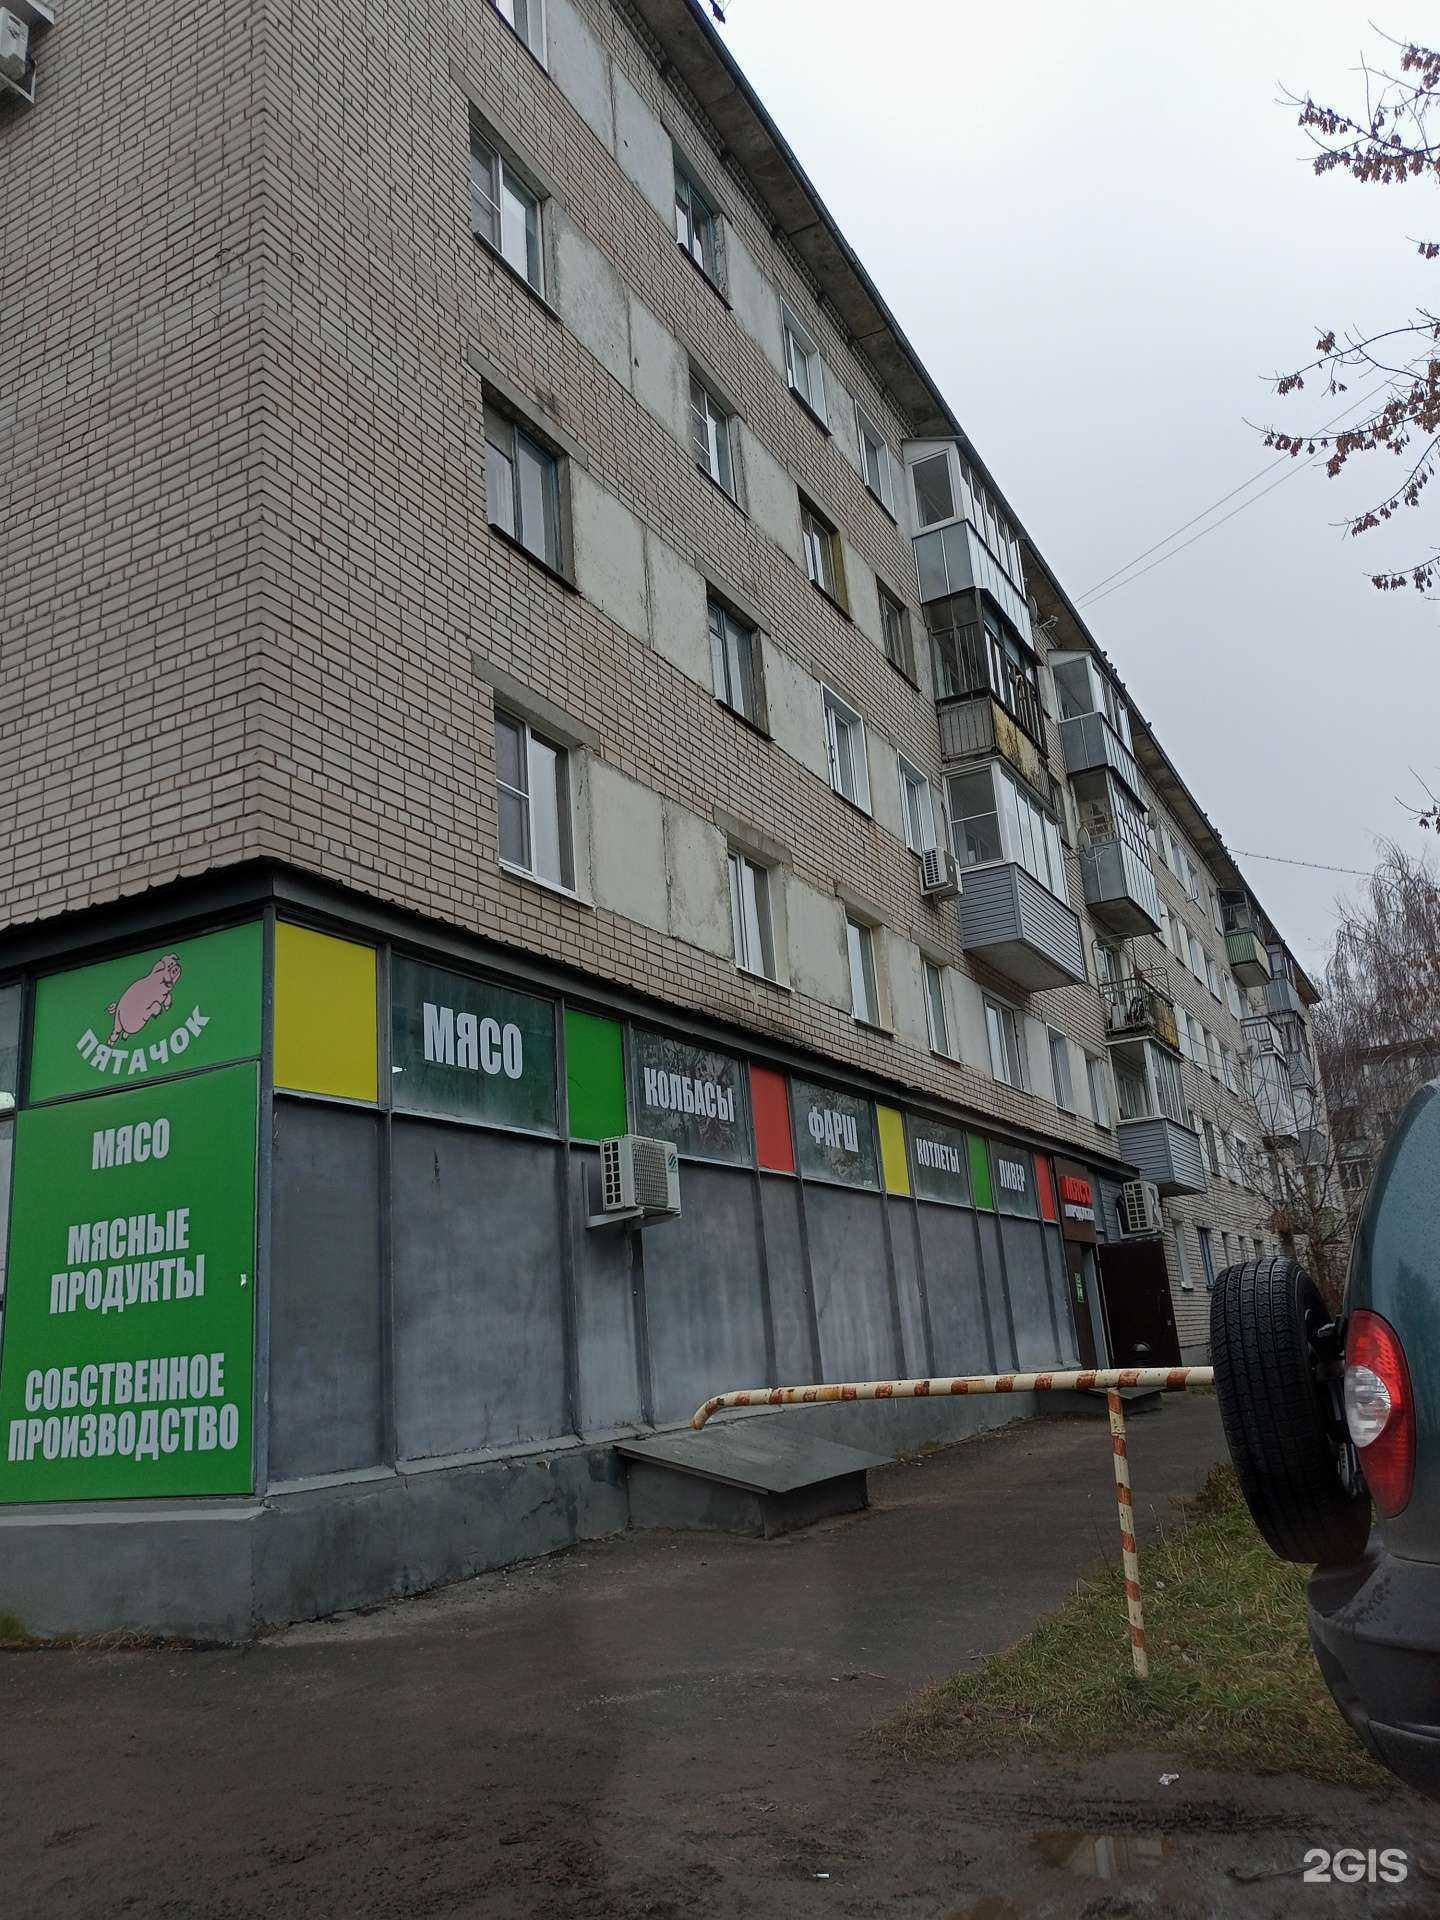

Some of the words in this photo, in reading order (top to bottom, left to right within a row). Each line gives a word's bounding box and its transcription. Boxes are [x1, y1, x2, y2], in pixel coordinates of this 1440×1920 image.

[76, 1005, 211, 1075] ПЯТАЧОК
[423, 1002, 523, 1080] МЯСО
[643, 1067, 735, 1122] КОЛБАСЫ
[92, 1118, 170, 1170] МЯСО
[808, 1106, 858, 1153] ФАРШ
[916, 1138, 960, 1174] КОТЛЕТЫ
[999, 1159, 1025, 1192] ЛИВЕР
[67, 1208, 189, 1265] МЯСНЫЕ
[50, 1254, 205, 1315] ПРОДУКТЫ
[25, 1352, 225, 1412] СОБСТВЕННОЕ
[8, 1402, 239, 1461] ПРОИЗВОДСТВО
